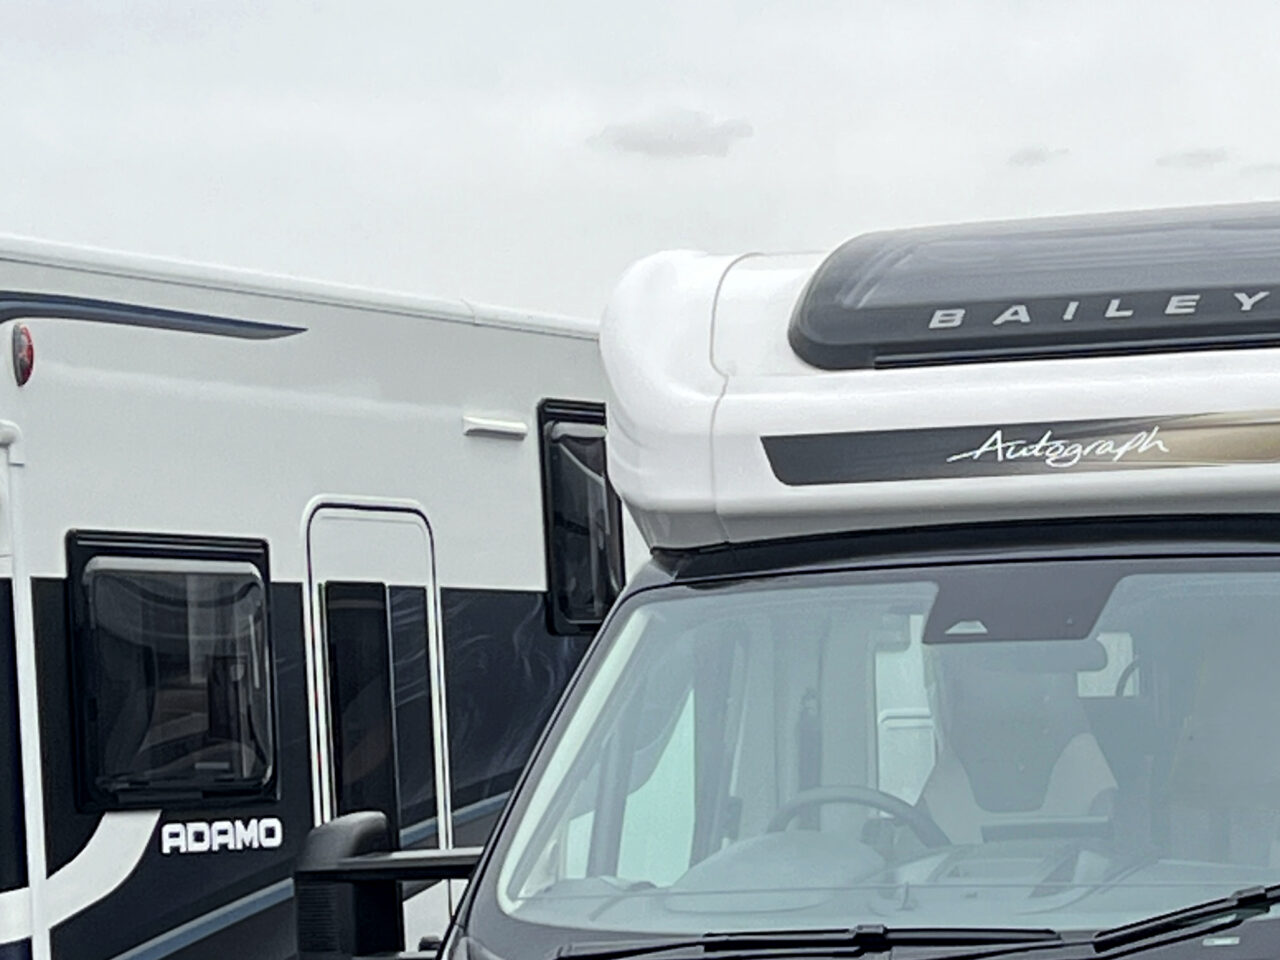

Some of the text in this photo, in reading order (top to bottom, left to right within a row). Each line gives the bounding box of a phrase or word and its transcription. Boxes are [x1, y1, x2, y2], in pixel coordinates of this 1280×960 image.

[928, 291, 1270, 329] BAILEY
[947, 426, 1169, 467] Autograph
[162, 818, 282, 854] ADAMO
